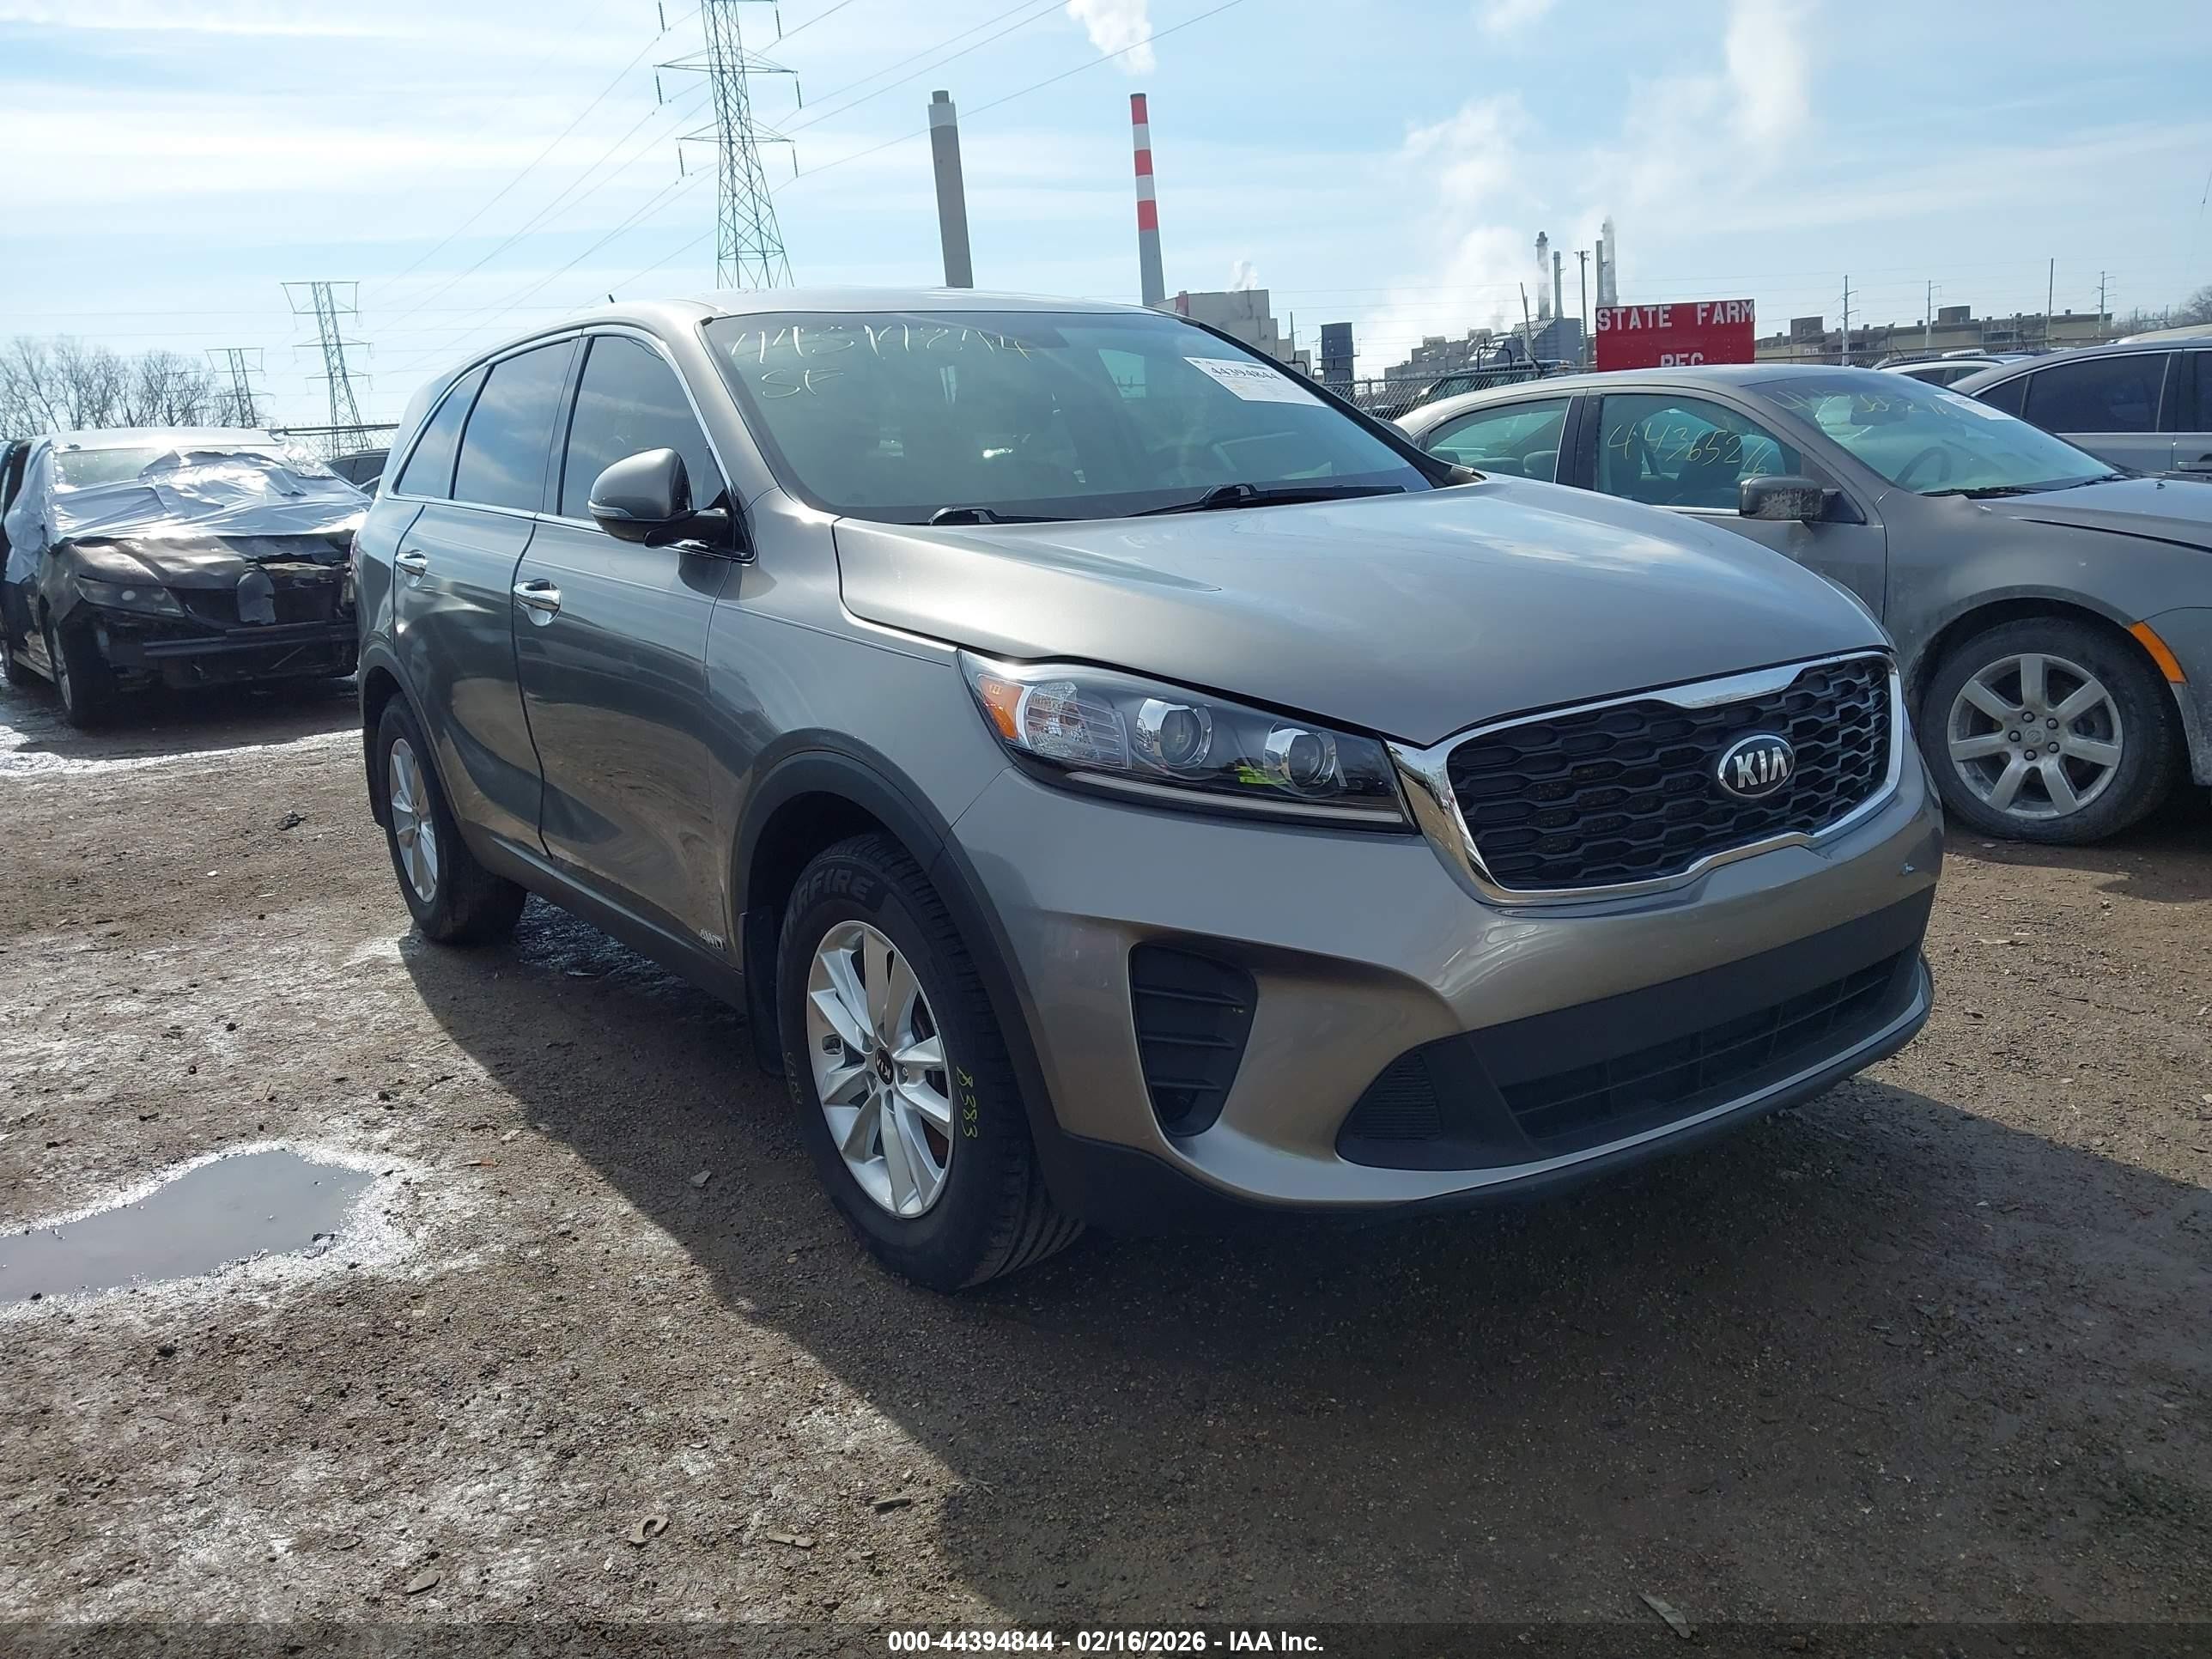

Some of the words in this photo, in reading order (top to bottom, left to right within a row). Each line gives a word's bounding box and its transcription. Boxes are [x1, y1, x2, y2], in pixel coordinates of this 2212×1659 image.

[1596, 304, 1673, 331] STATE
[1697, 301, 1754, 325] FARM
[1211, 366, 1280, 380] 44394844
[1734, 746, 1788, 788] KIA
